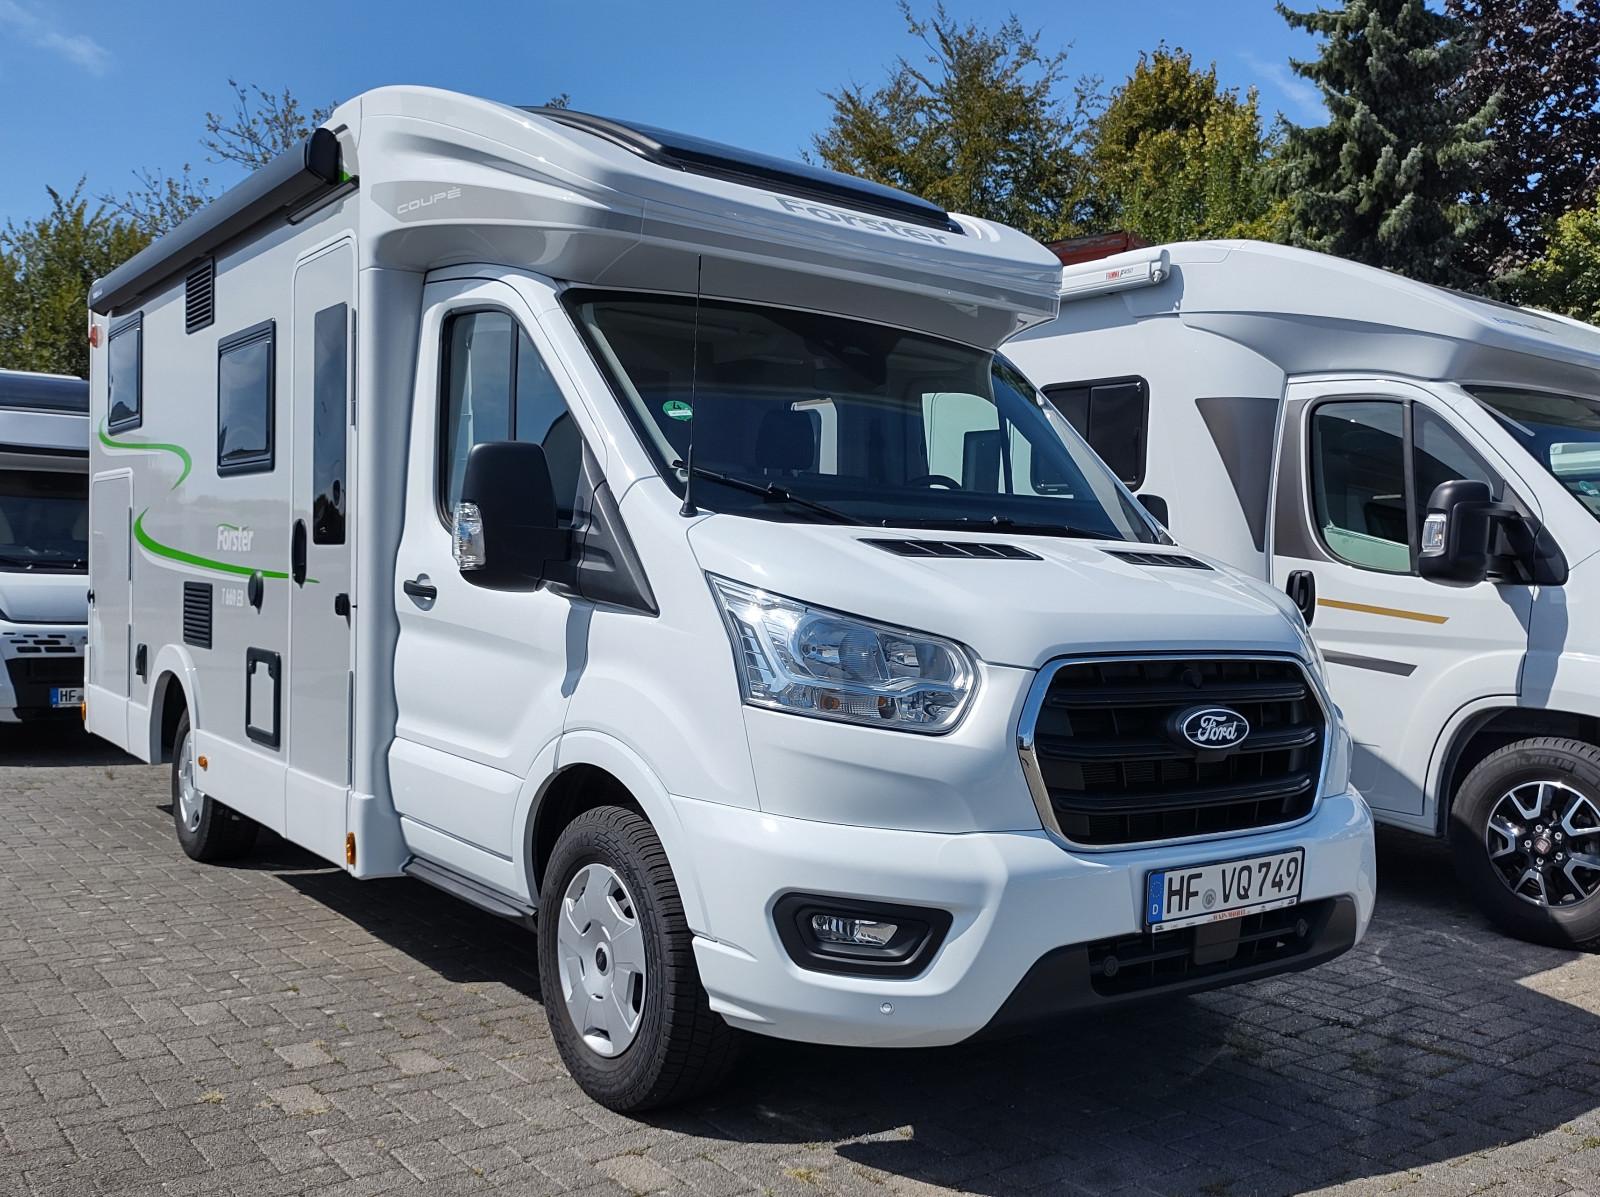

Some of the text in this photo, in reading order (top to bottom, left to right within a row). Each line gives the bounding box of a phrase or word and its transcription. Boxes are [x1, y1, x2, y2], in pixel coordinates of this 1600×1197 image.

[775, 196, 948, 246] Forster
[216, 526, 254, 552] Forster
[60, 690, 77, 702] HF
[1198, 715, 1237, 741] Ford
[1167, 857, 1299, 914] HF VQ 749
[1152, 905, 1159, 914] D
